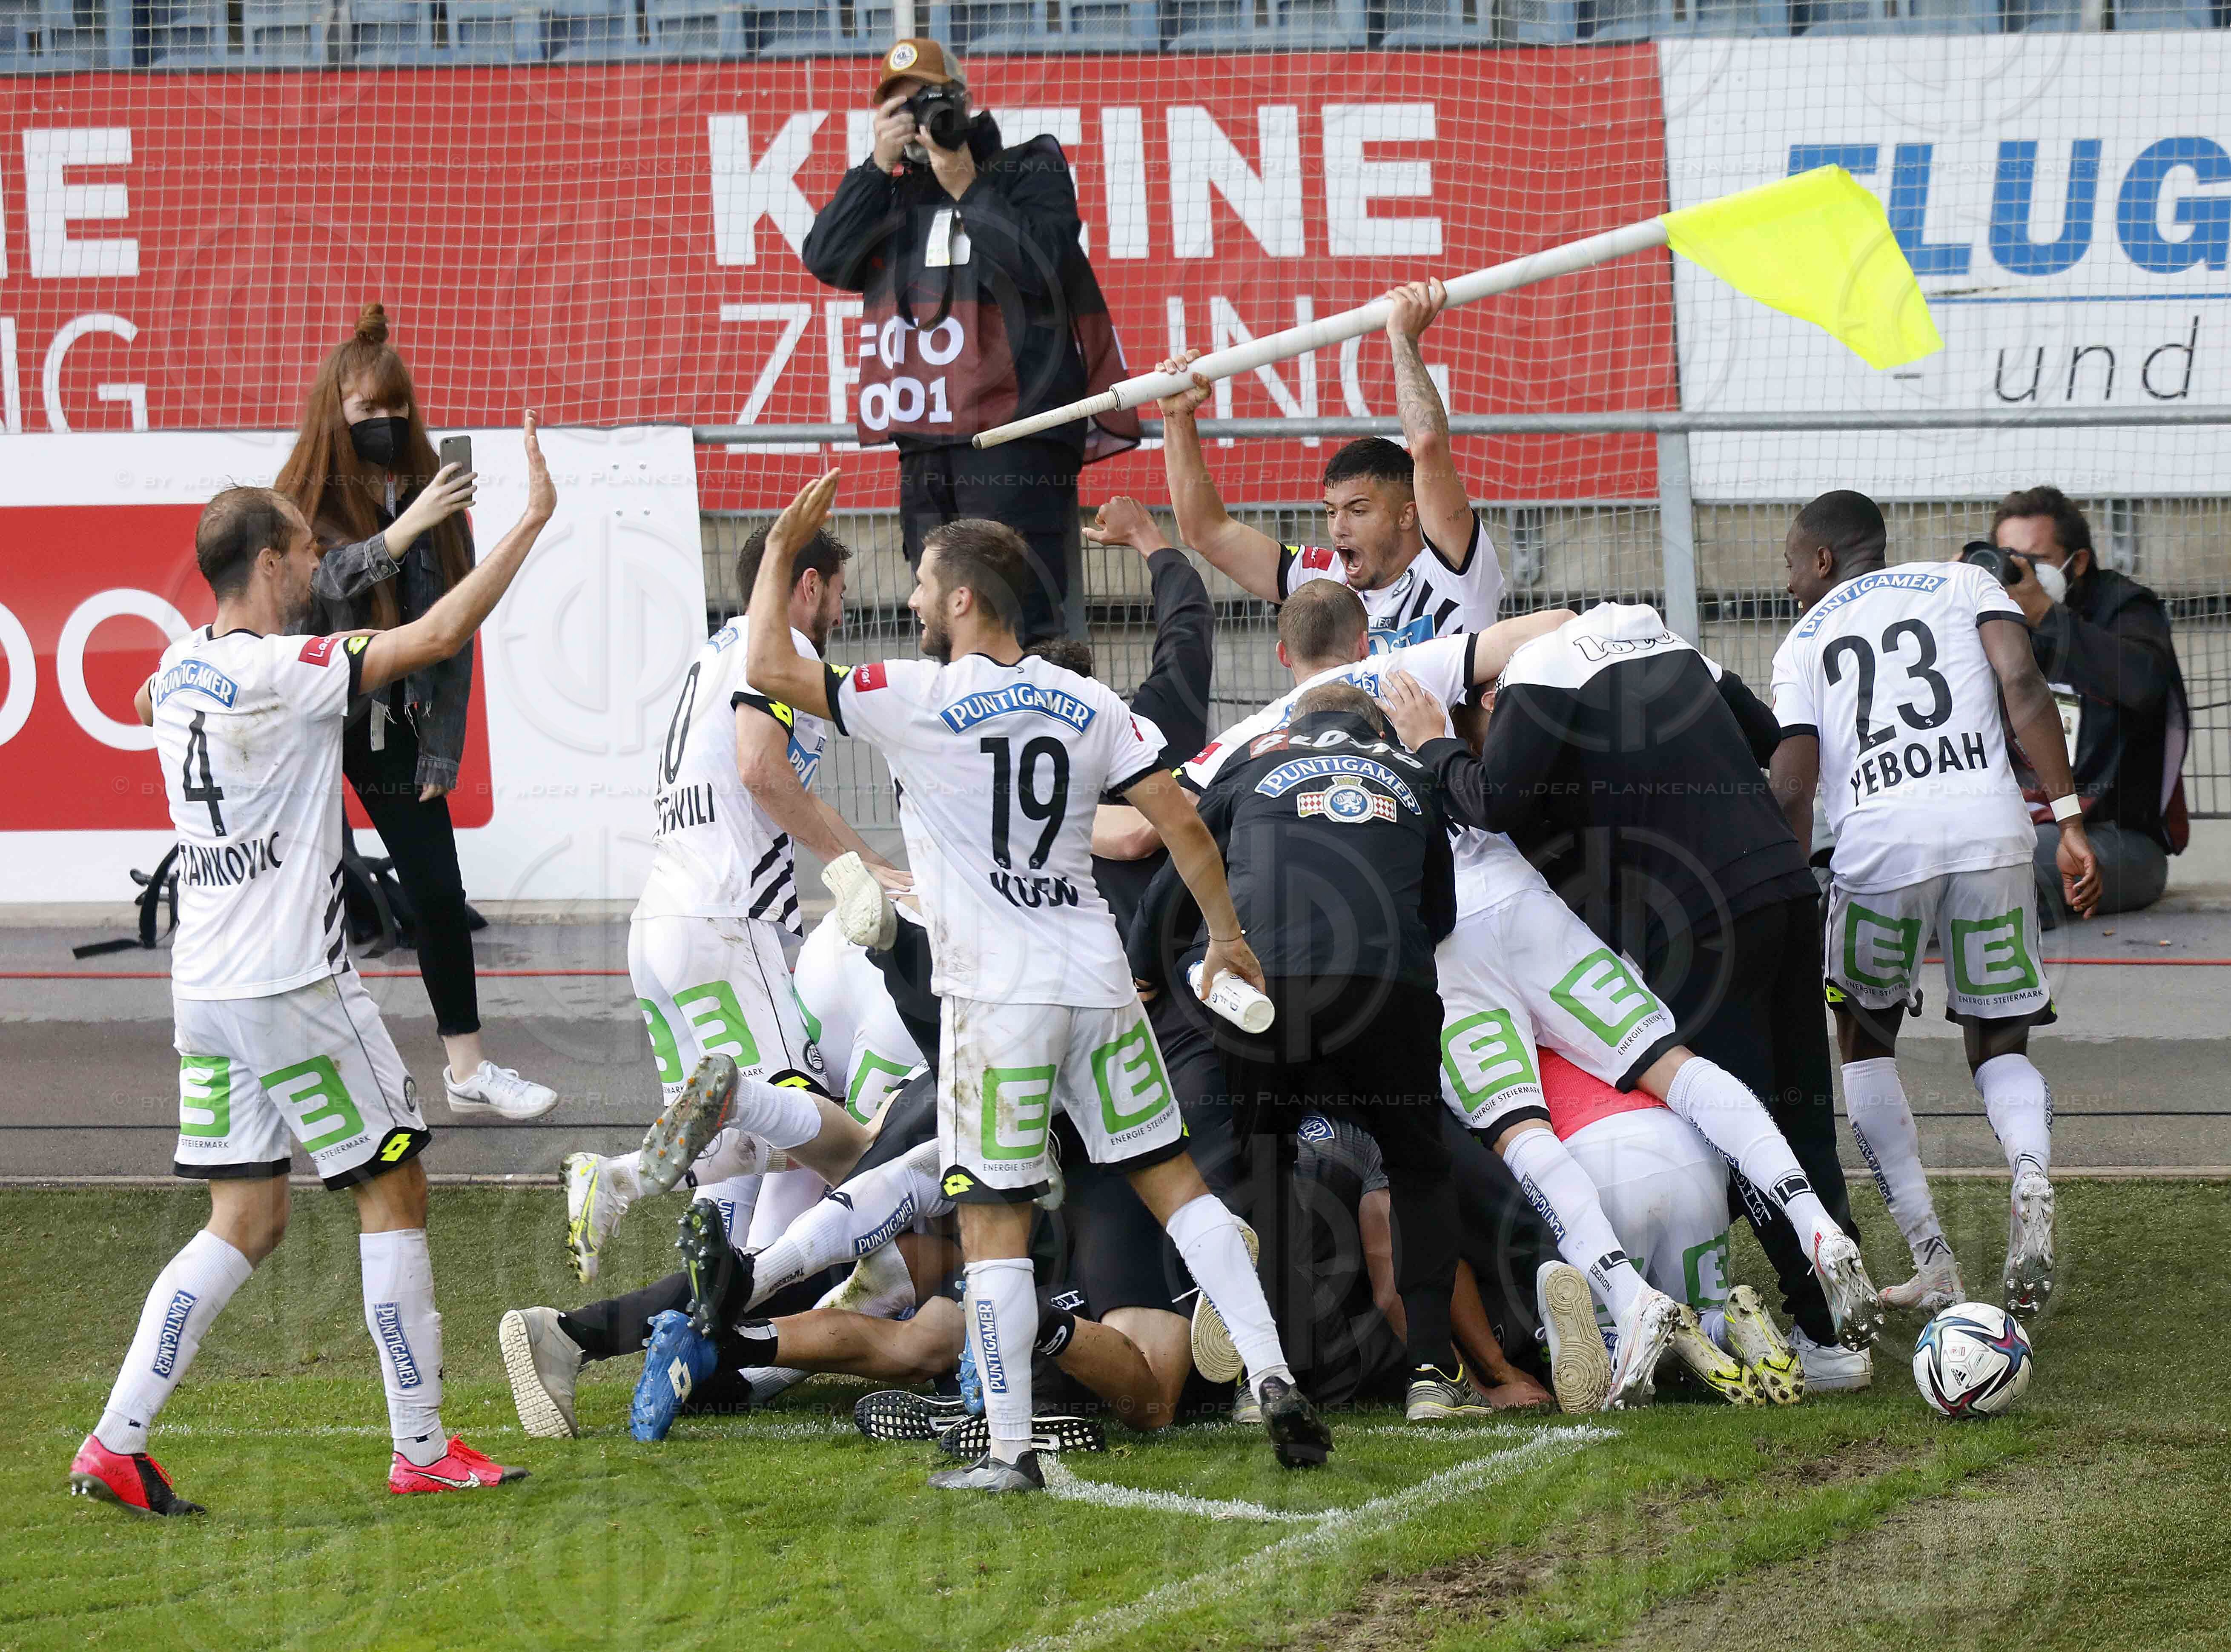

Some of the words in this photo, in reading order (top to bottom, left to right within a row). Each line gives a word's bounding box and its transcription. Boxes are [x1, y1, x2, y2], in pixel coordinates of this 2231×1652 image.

[1994, 315, 2200, 402] und
[860, 376, 953, 431] 001
[1803, 574, 1940, 634] PUNTIGAMER
[946, 687, 1089, 729] PUNTIGAMER
[1823, 619, 1953, 758] 23
[183, 710, 227, 837] 4
[1263, 757, 1417, 812] PUNTIGAMER
[1850, 732, 1989, 807] YEBOAH
[980, 737, 1070, 869] 19
[177, 831, 283, 886] TANKOVIC
[1959, 995, 1990, 1006] ENERGIE
[1993, 990, 2044, 1004] STEIERMARK
[1618, 1026, 1643, 1056] ENERGIE
[1471, 1098, 1497, 1124] ENERGIE
[1497, 1085, 1541, 1102] STEIERMARK
[181, 1138, 229, 1149] STEIERMARK
[321, 1135, 372, 1161] STEIERMARK
[1110, 1127, 1145, 1146] ENERGIE
[984, 1164, 1018, 1172] ENERGIE
[1522, 1174, 1566, 1241] PUNTIGAMER
[155, 1292, 195, 1375] PUNTIGAMER
[376, 1307, 419, 1386] PUNTIGAMER
[978, 1303, 1006, 1391] PUNTIGAMER
